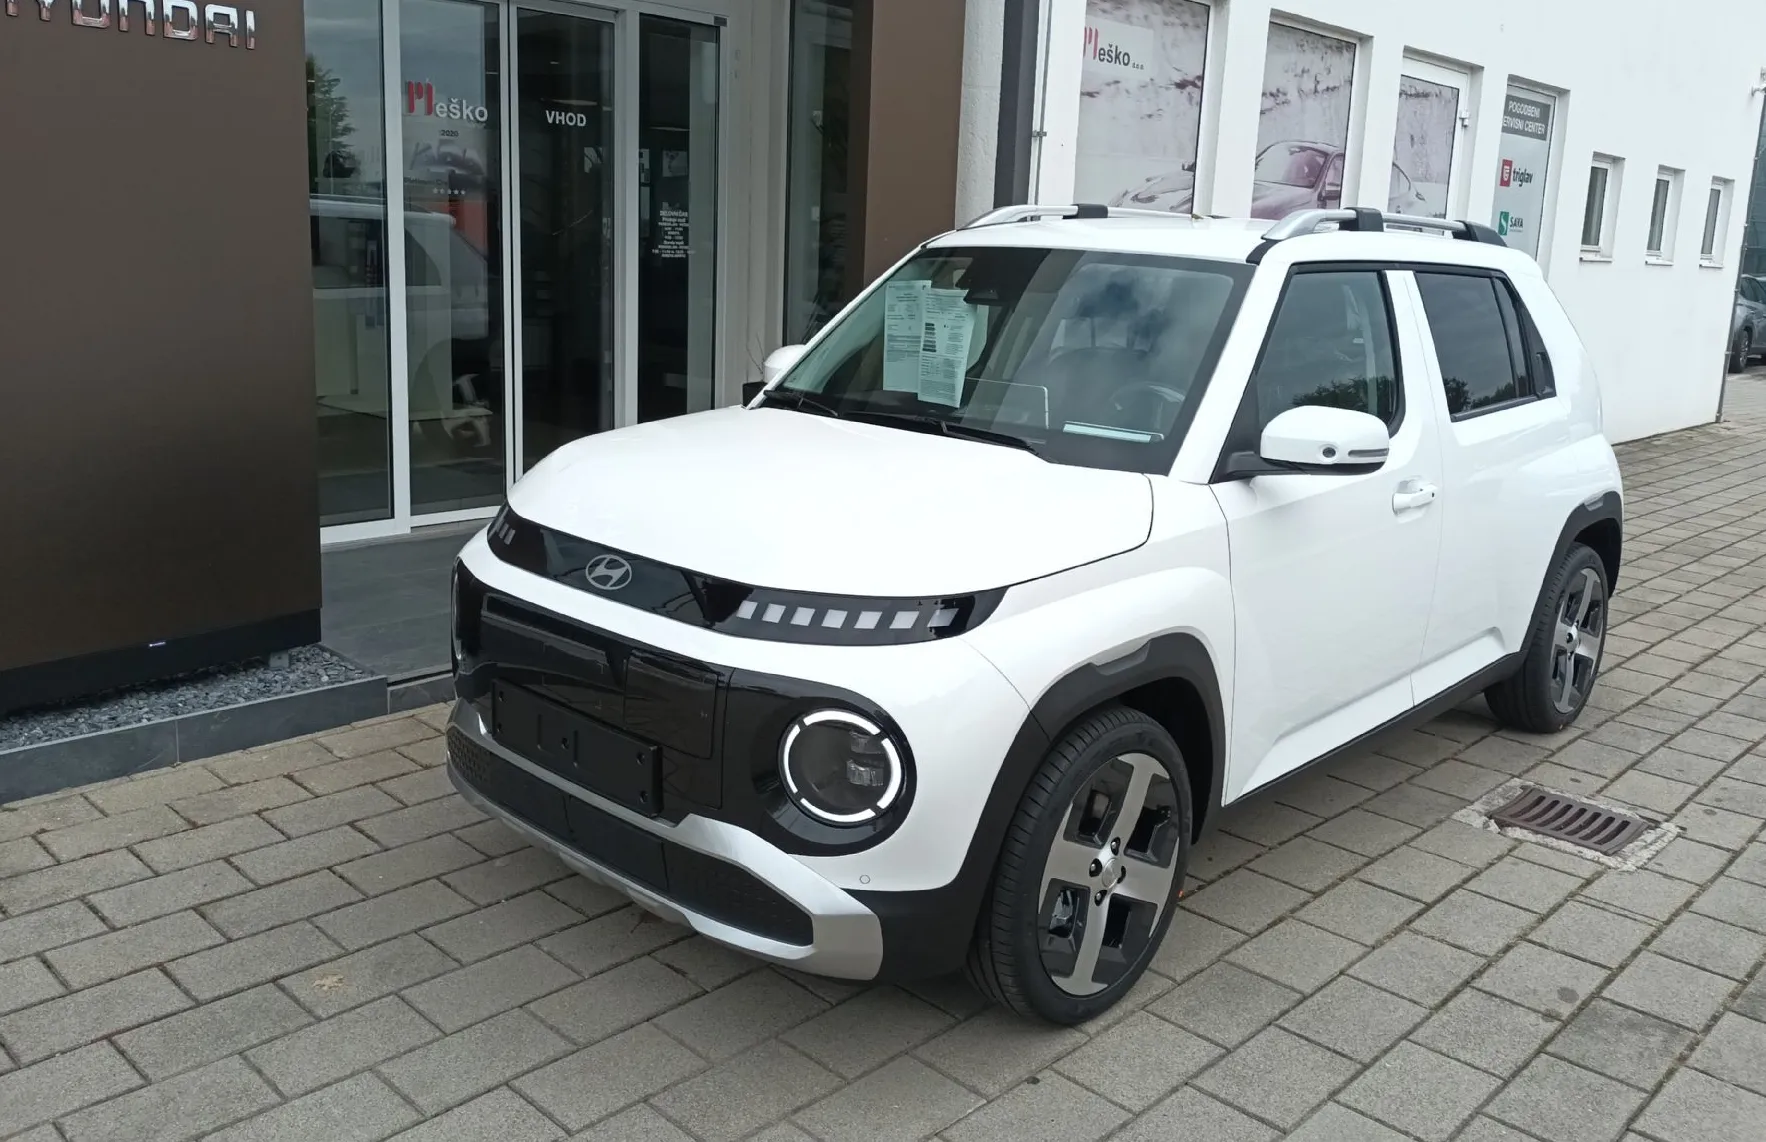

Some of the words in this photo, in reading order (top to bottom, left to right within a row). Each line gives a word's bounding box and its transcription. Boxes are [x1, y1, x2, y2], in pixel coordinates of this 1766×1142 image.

[407, 80, 488, 122] Meško
[545, 109, 587, 127] VHOD
[1512, 167, 1533, 187] triglav
